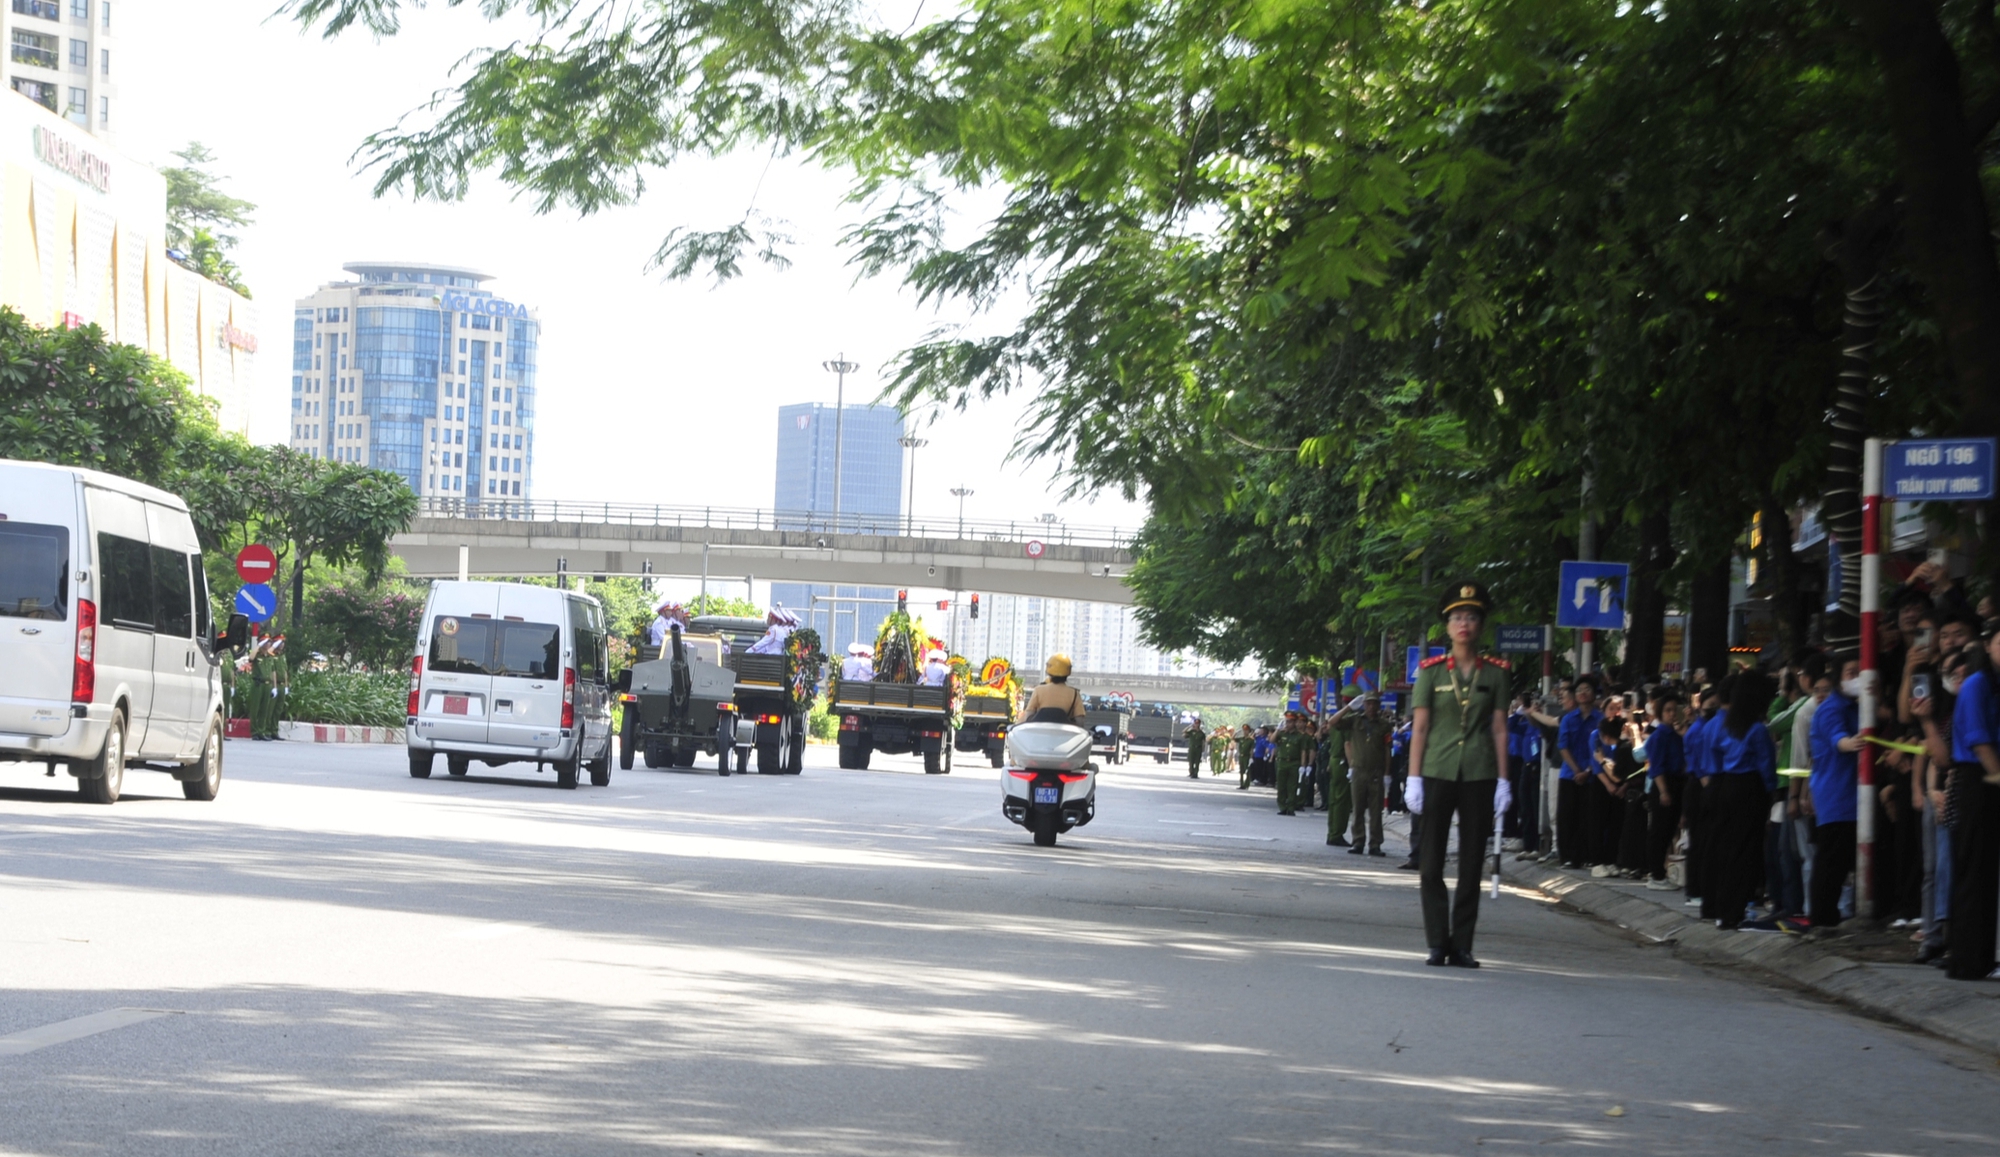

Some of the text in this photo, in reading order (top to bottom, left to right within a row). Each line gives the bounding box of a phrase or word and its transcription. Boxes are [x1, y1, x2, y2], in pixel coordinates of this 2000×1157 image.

[1944, 446, 1975, 465] 196
[1926, 478, 1947, 494] DUY
[1522, 630, 1537, 638] 204
